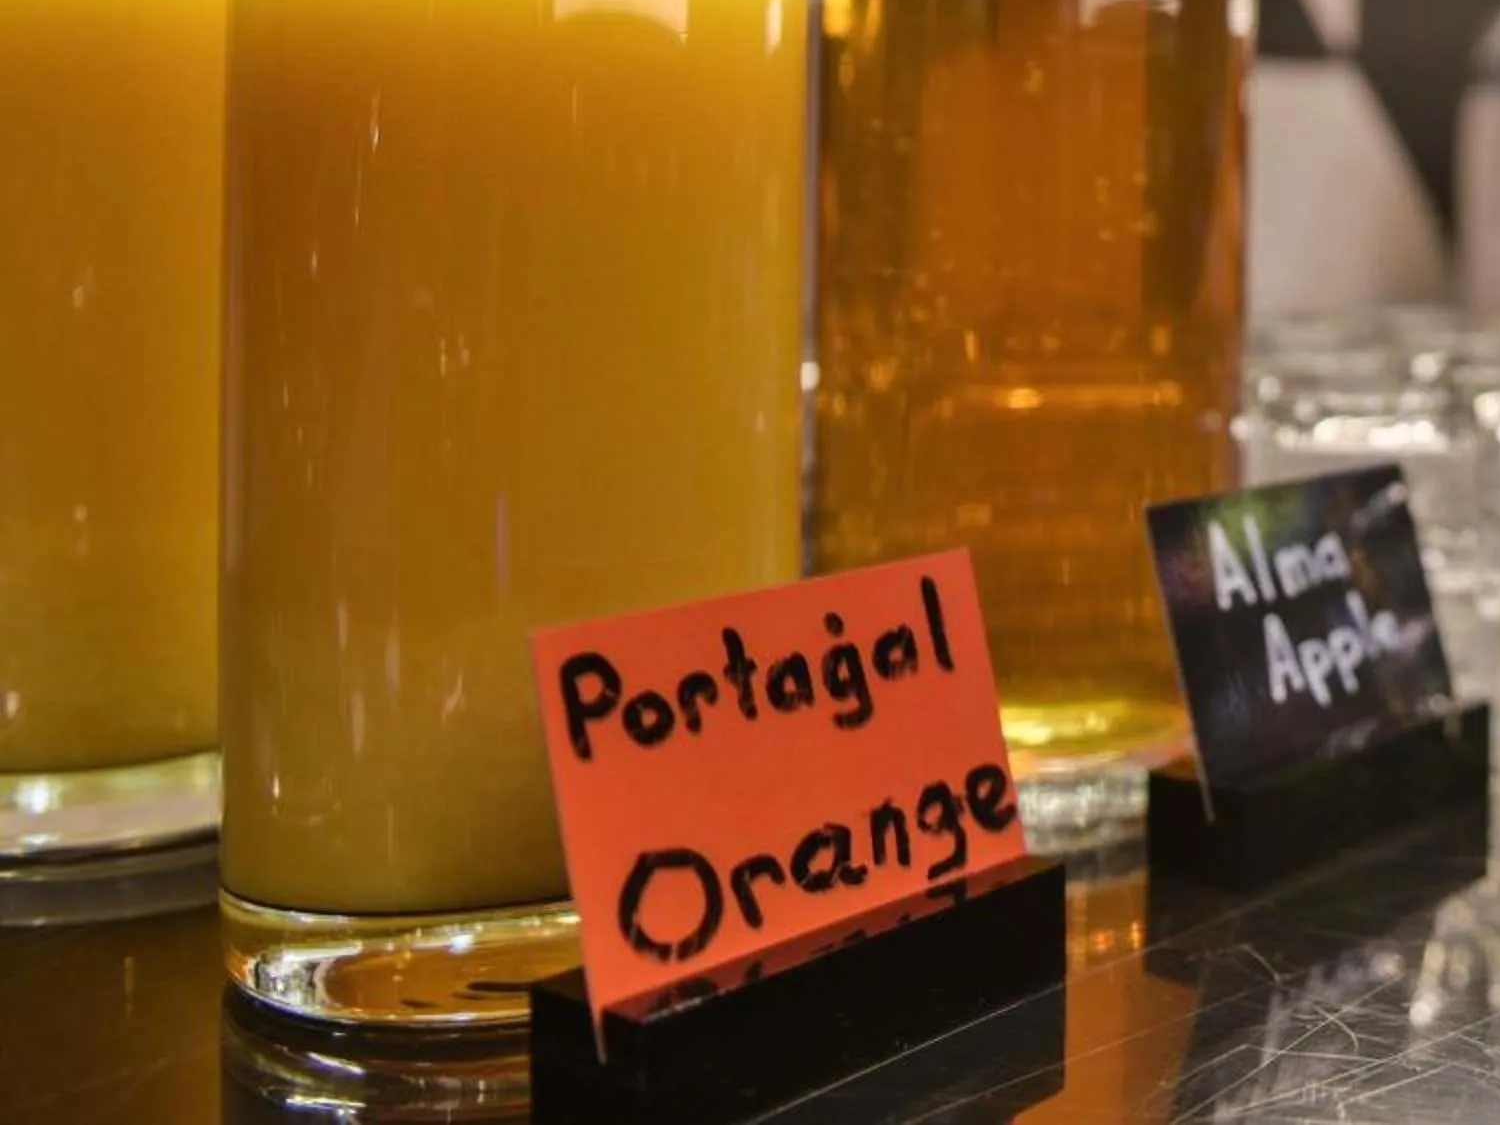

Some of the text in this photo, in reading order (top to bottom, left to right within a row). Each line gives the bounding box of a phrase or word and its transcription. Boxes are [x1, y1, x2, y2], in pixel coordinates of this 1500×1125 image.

[1208, 513, 1352, 611] Alma
[1262, 590, 1414, 706] Apple
[618, 764, 1018, 962] Orange
